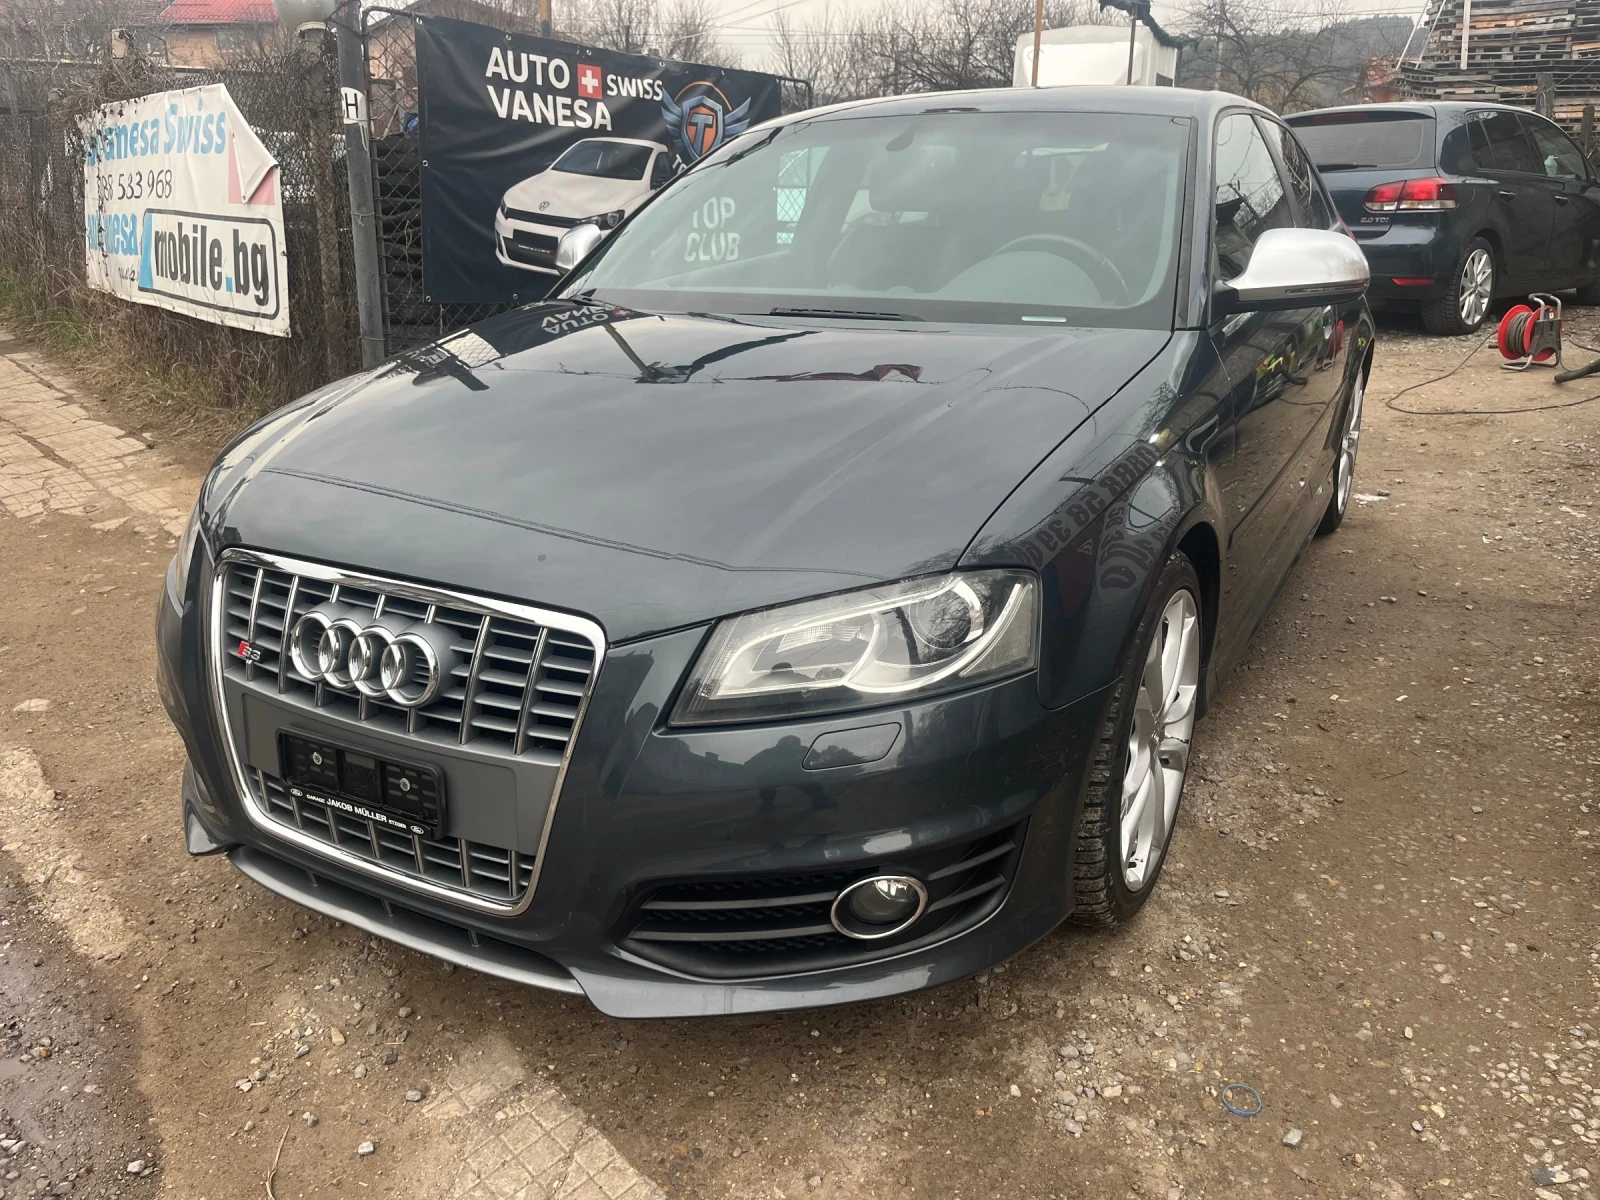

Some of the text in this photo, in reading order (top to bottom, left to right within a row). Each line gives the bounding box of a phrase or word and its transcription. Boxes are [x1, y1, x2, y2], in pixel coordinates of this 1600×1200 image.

[485, 46, 663, 101] AUTO SWISS
[164, 98, 226, 155] Swiss
[486, 85, 612, 131] VANESA
[147, 168, 172, 199] 968
[154, 221, 270, 307] mobile.bg
[684, 232, 740, 262] CLUB
[306, 794, 325, 804] GARAGE
[326, 798, 353, 812] JAKOB
[354, 806, 388, 823] MÜLLER
